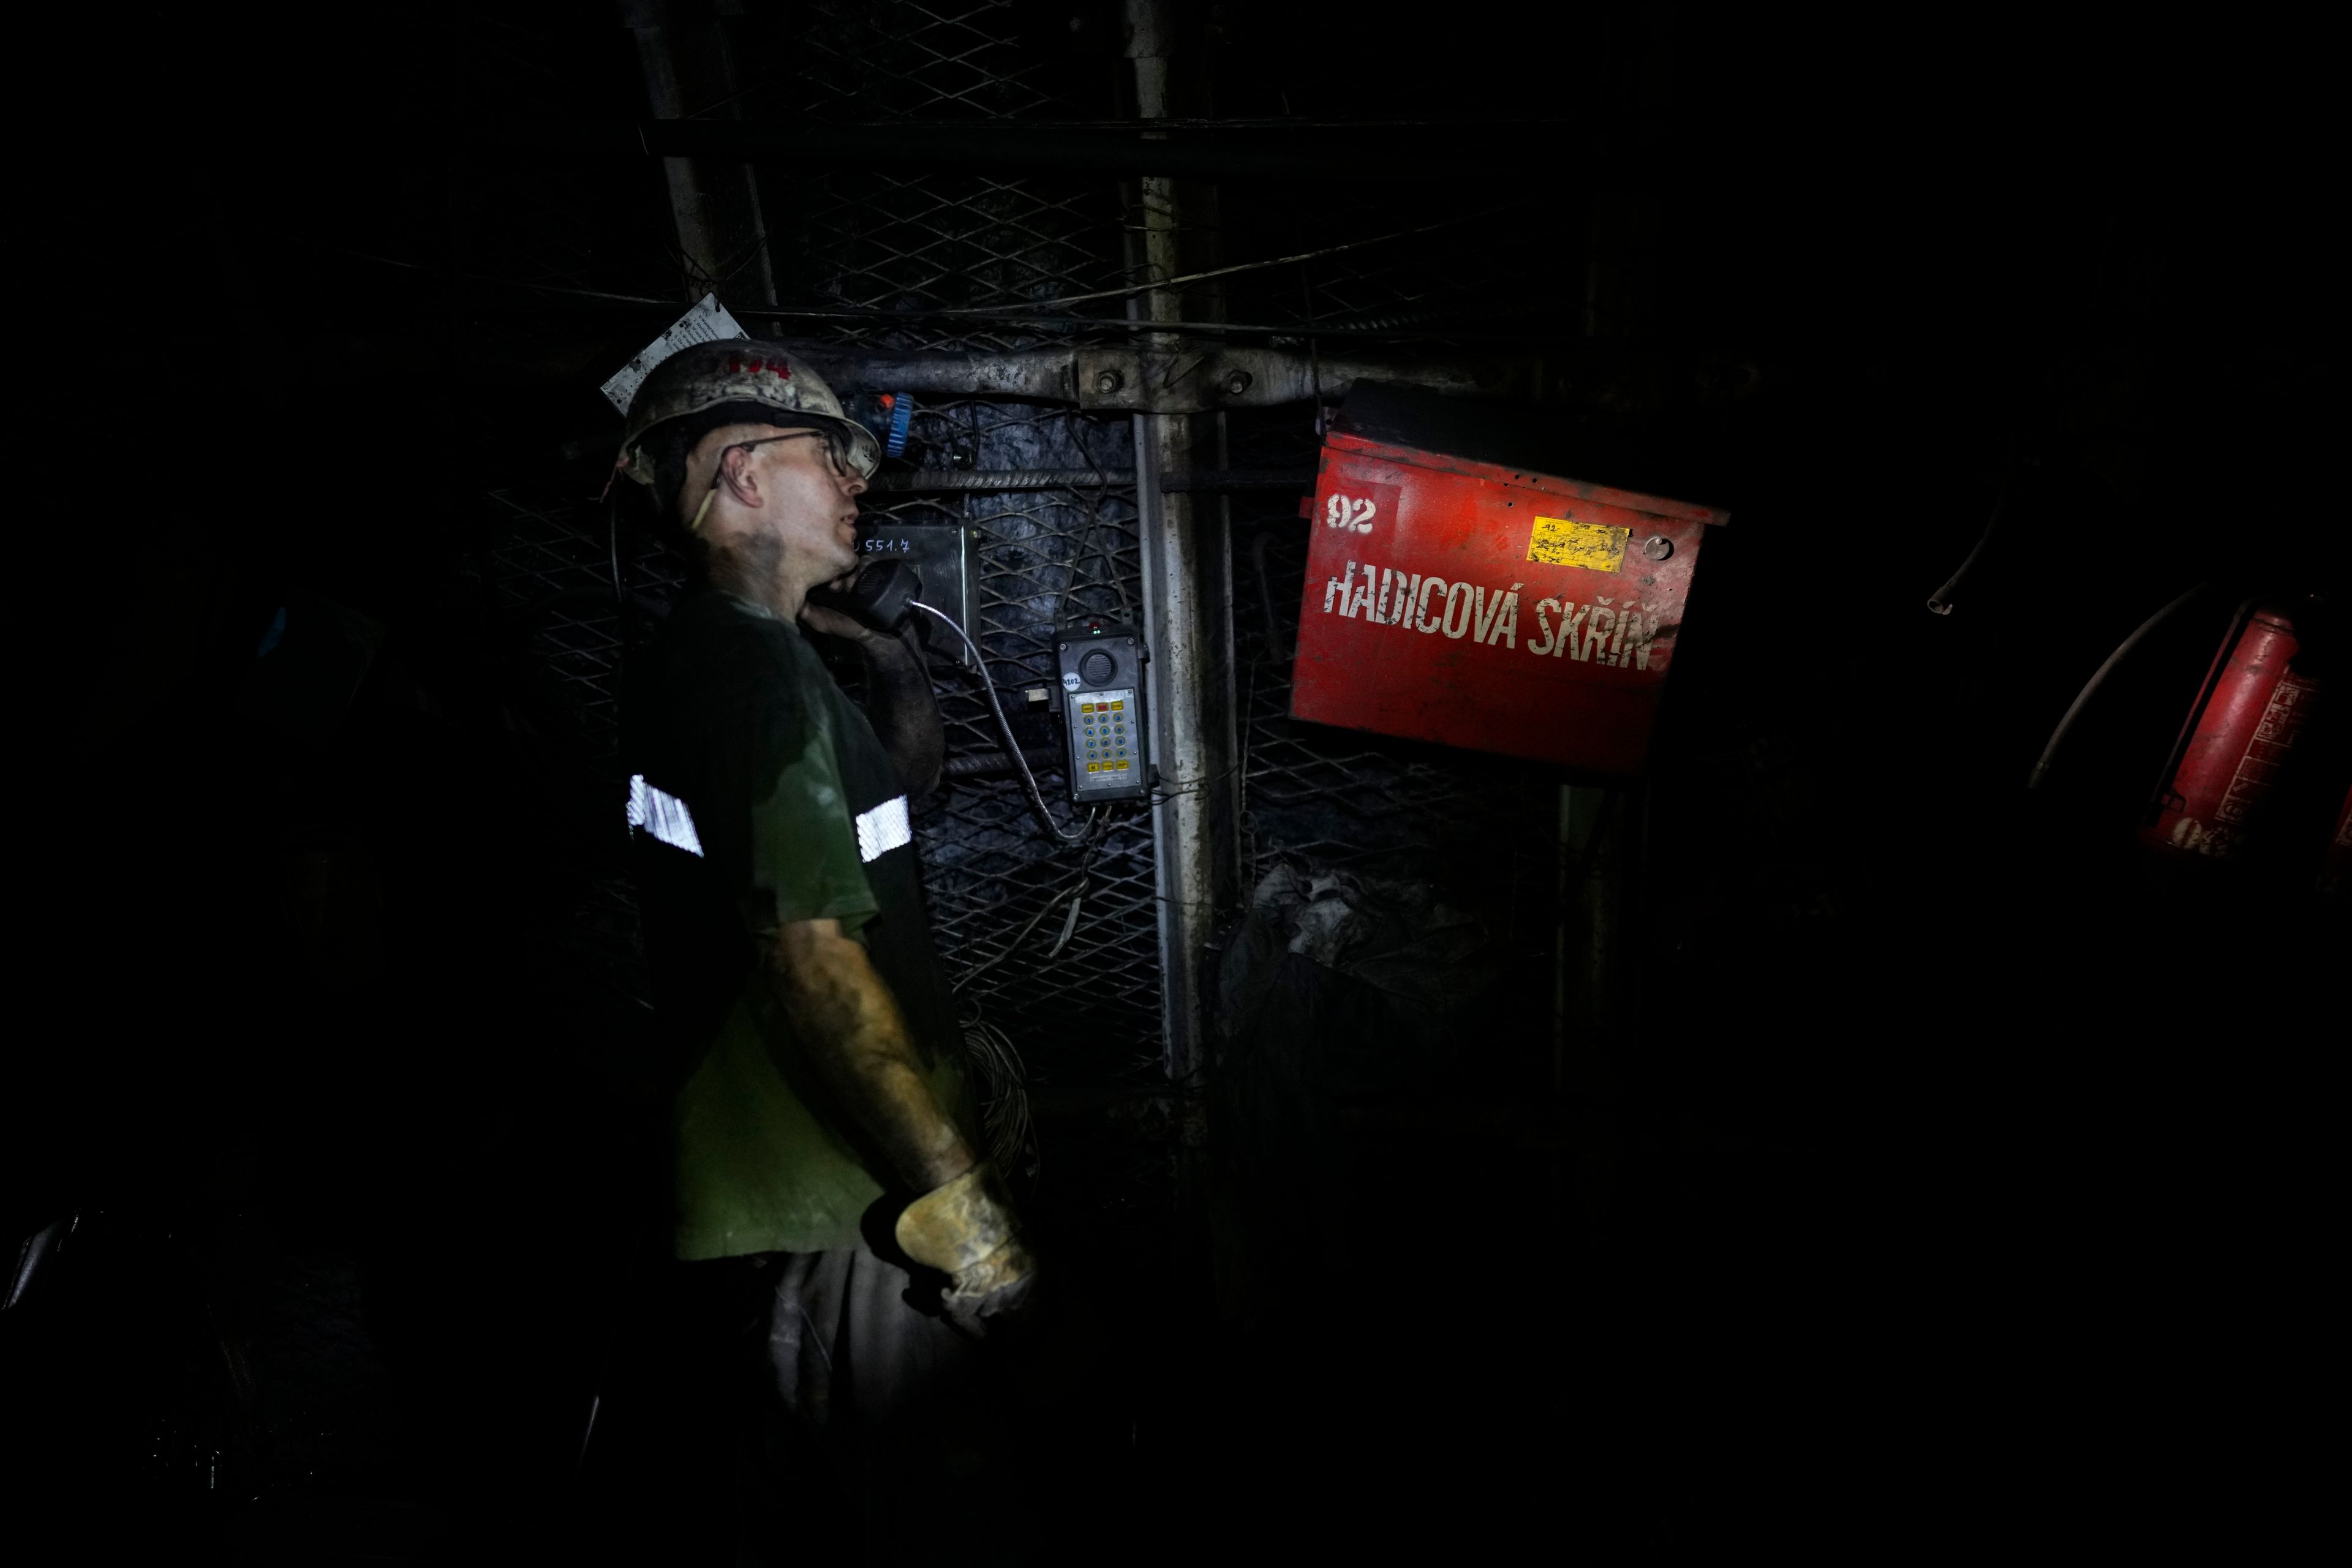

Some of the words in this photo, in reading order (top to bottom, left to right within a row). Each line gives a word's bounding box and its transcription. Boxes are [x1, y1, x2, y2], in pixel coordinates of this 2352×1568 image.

[1326, 493, 1376, 534] 92
[1324, 560, 1525, 649] HADICOVÁ
[1528, 596, 1660, 671] SKŘÍŇ
